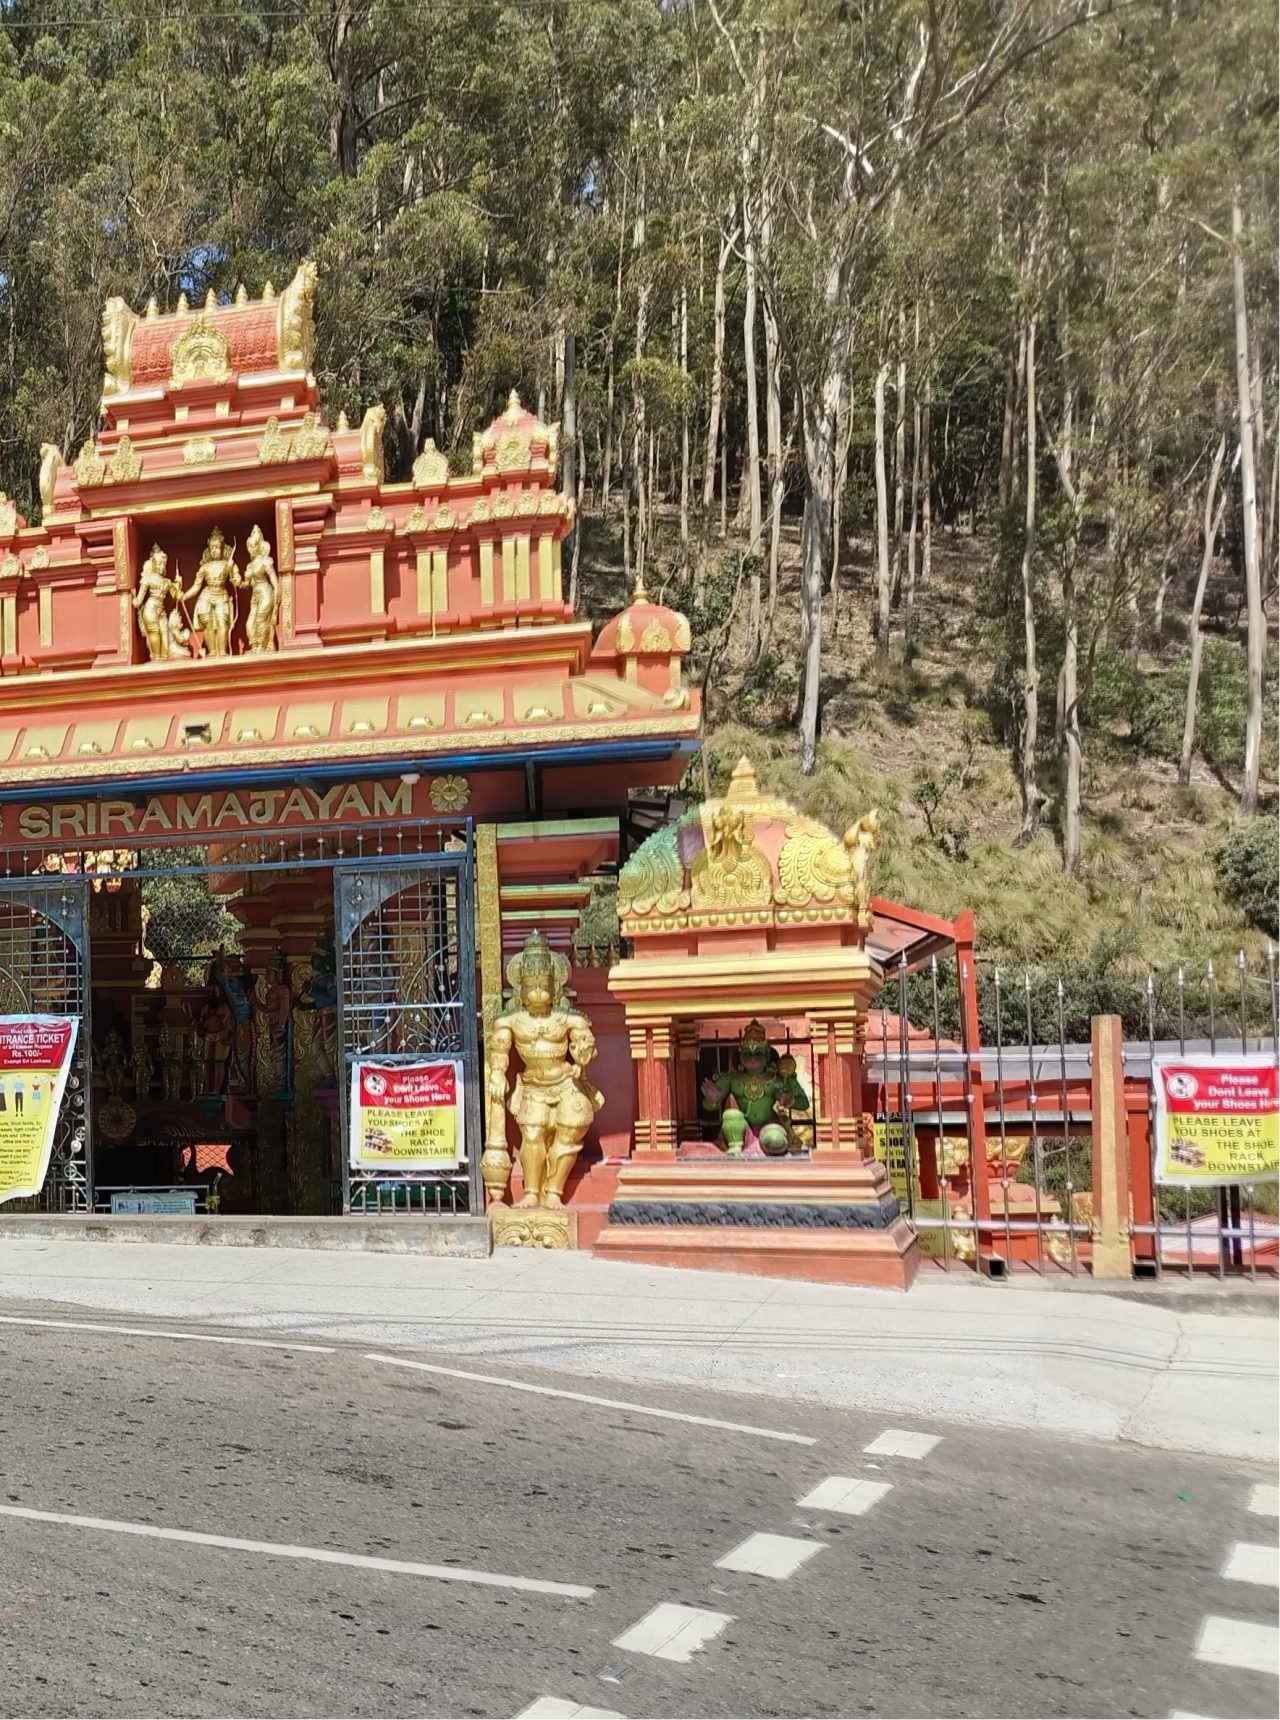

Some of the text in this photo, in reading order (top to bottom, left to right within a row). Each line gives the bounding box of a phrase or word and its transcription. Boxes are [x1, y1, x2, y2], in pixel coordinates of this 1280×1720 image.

[19, 782, 413, 839] SRIRAMAJAYAM
[36, 1033, 65, 1044] TICKET
[402, 1075, 429, 1084] Please
[1221, 1073, 1259, 1085] Please
[415, 1084, 439, 1093] Leave
[384, 1092, 451, 1105] your Shoes Here
[1193, 1099, 1220, 1110] your
[1222, 1098, 1257, 1109] Shoes
[368, 1109, 434, 1118] PLEASE LEAVE
[1172, 1115, 1263, 1127] PLEASE LEAVE
[1201, 1129, 1243, 1137] SHOES
[1247, 1129, 1261, 1137] AT
[1216, 1138, 1276, 1150] THE SHOE
[394, 1147, 455, 1156] DOWNSTAIRS
[1230, 1150, 1265, 1161] RACK
